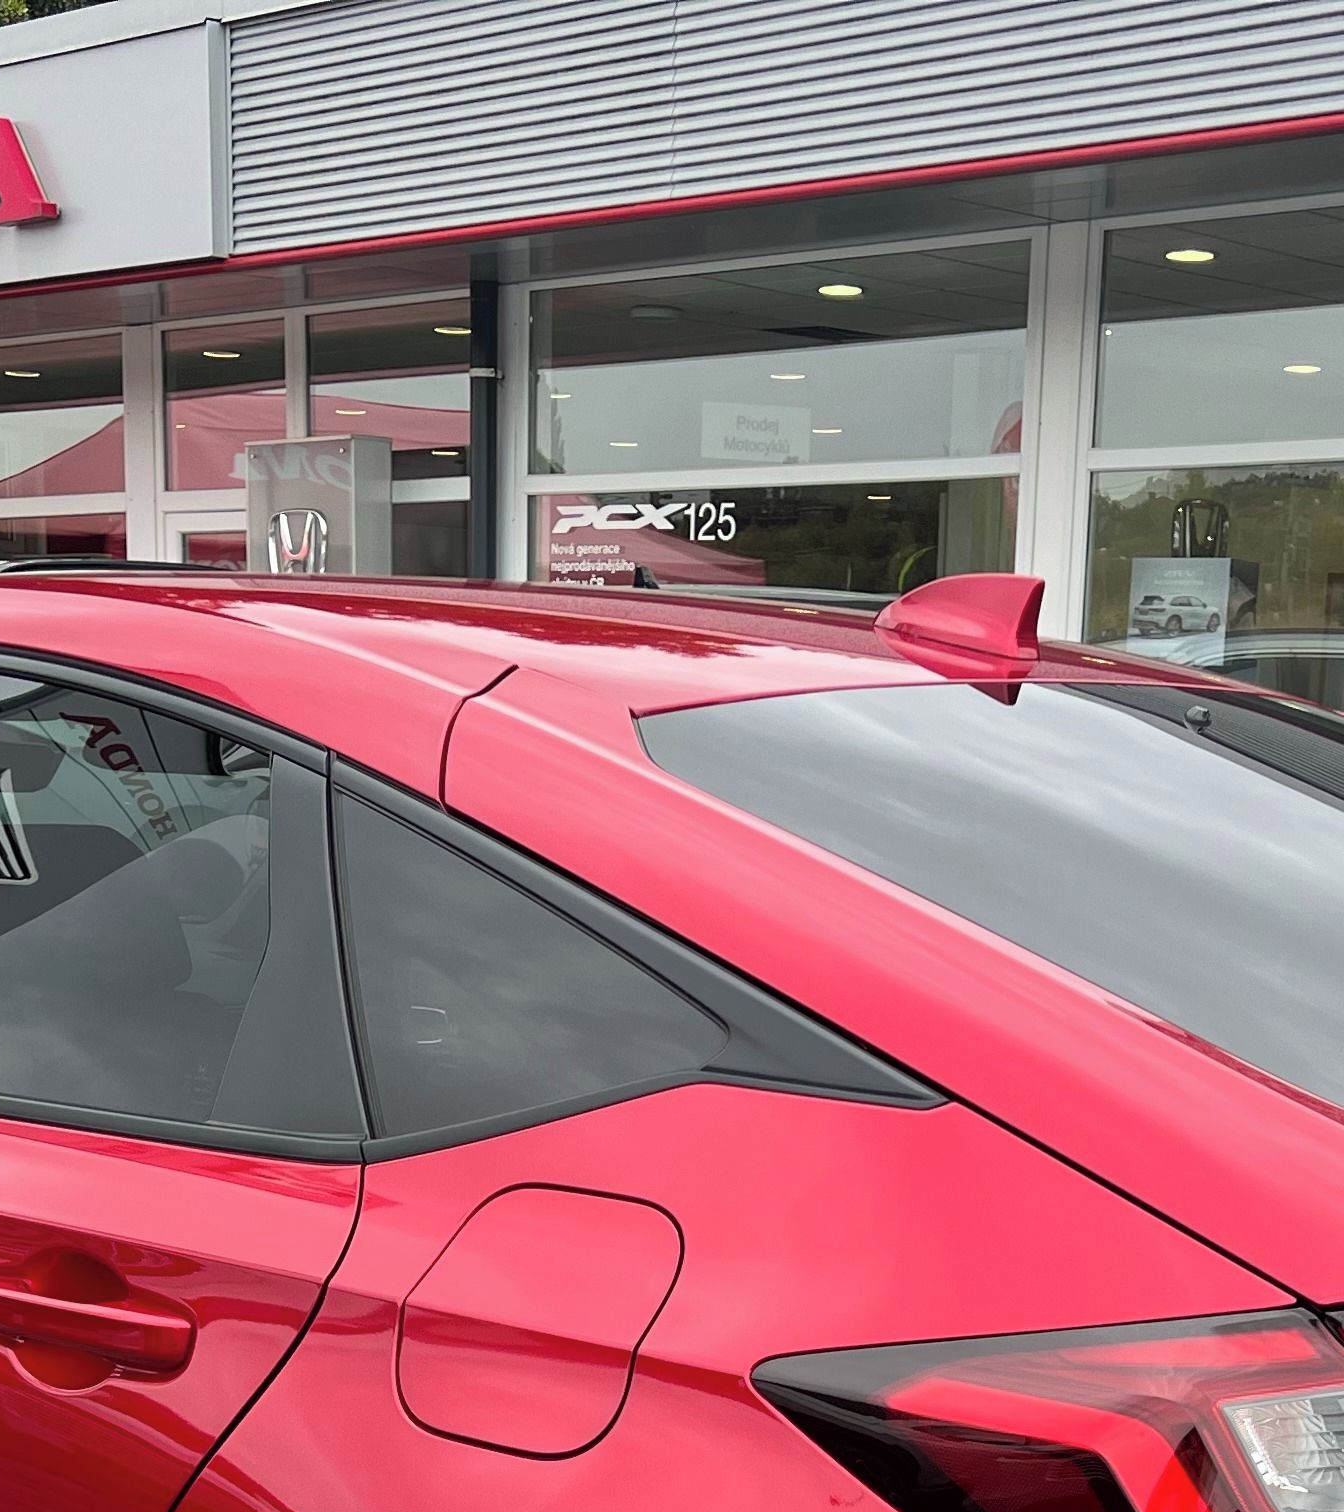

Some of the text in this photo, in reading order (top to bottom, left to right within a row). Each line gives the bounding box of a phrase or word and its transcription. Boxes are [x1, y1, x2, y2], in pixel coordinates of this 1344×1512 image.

[736, 415, 780, 435] Prodej
[552, 502, 736, 541] PCX 125
[551, 542, 620, 557] Nová generace
